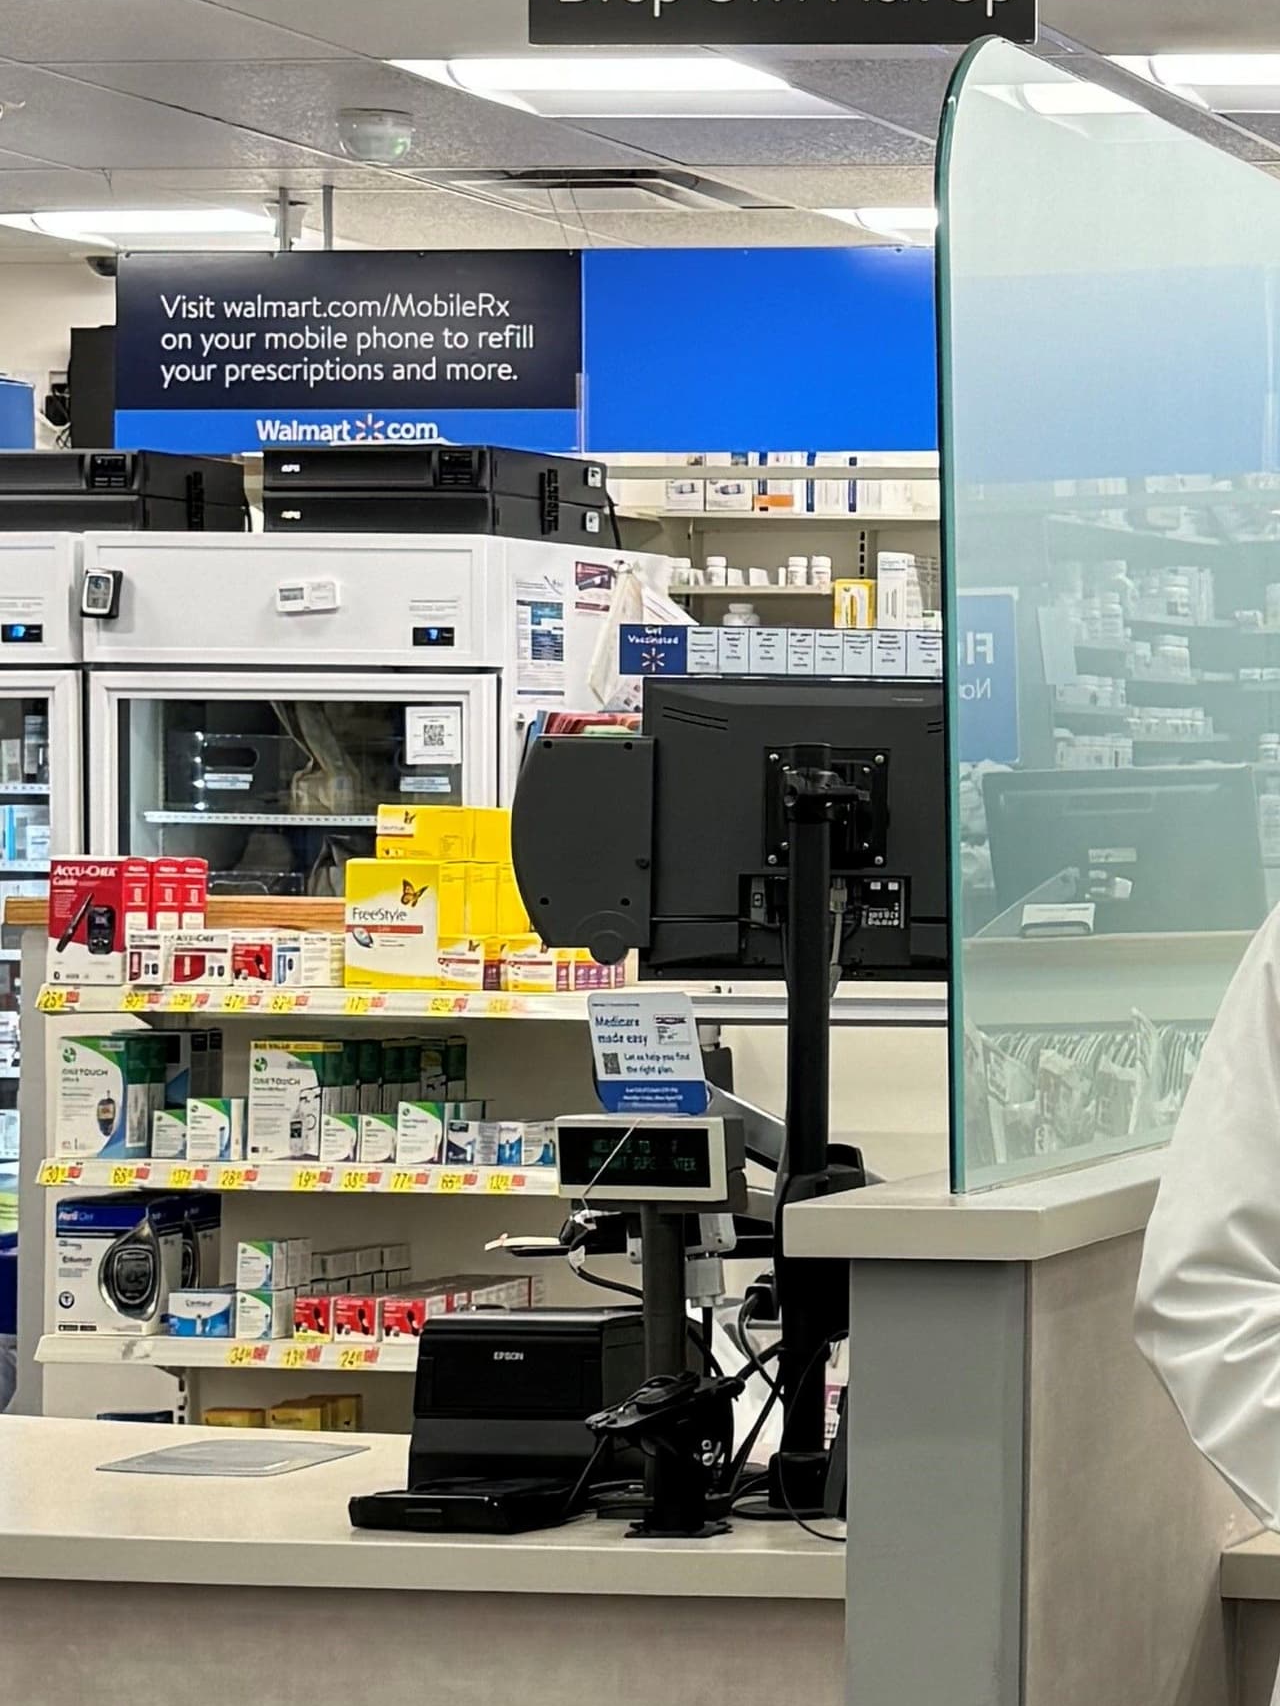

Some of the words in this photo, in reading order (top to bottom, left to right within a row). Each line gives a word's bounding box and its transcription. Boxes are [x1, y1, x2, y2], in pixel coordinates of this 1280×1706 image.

[160, 294, 215, 319] Visit
[223, 292, 510, 320] walmart.com/MobileRx
[160, 329, 192, 350] on
[199, 332, 257, 356] your
[265, 325, 348, 350] mobile
[356, 325, 435, 356] phone
[441, 327, 469, 349] to
[478, 323, 534, 349] refill
[160, 362, 217, 389] your
[225, 357, 385, 388] prescriptions
[392, 355, 437, 382] and
[446, 362, 518, 381] more.
[256, 419, 350, 441] Walmart
[352, 906, 408, 923] FreeStyle
[597, 1032, 624, 1044] made
